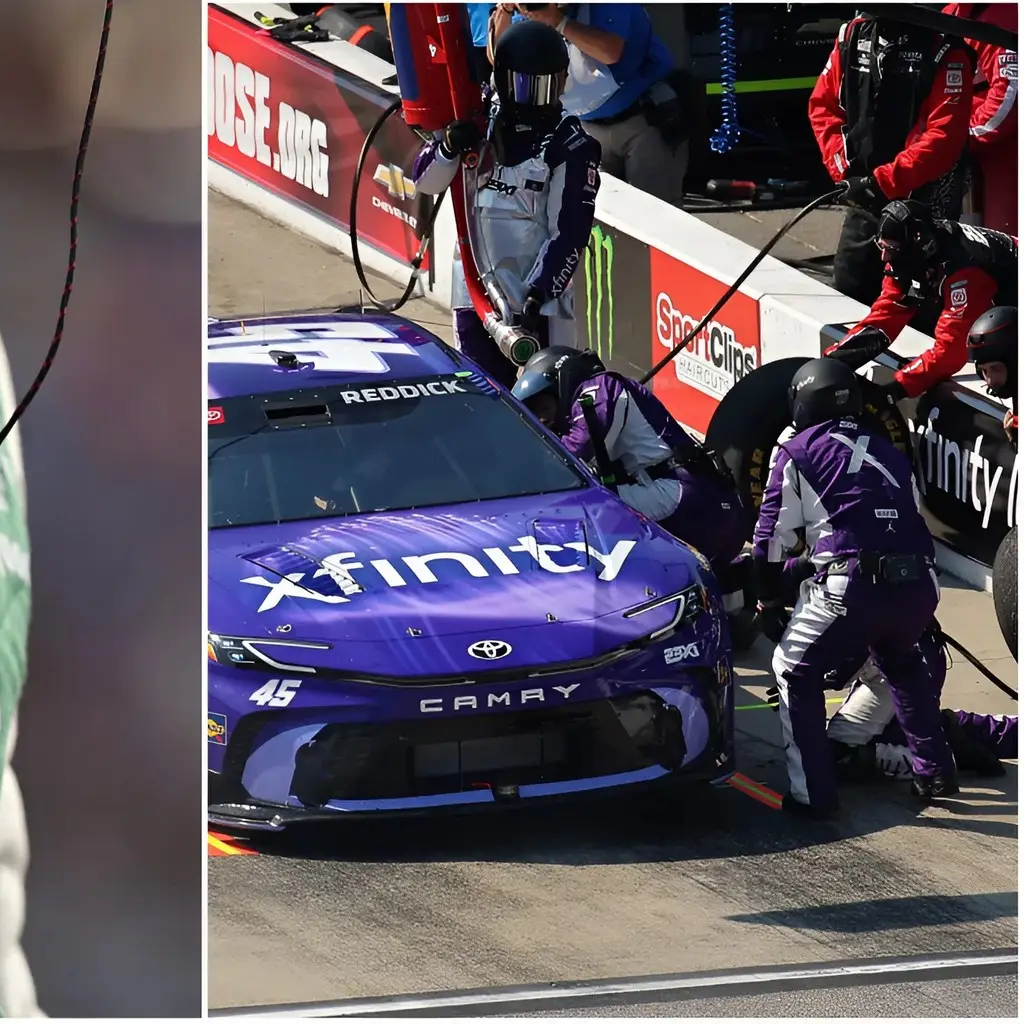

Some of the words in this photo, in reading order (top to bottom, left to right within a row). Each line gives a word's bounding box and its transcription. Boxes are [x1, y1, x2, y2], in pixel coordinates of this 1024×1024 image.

[340, 380, 466, 404] REDDICK
[240, 536, 637, 613] xfinity
[248, 679, 302, 707] 45
[420, 683, 581, 713] CAMRY
